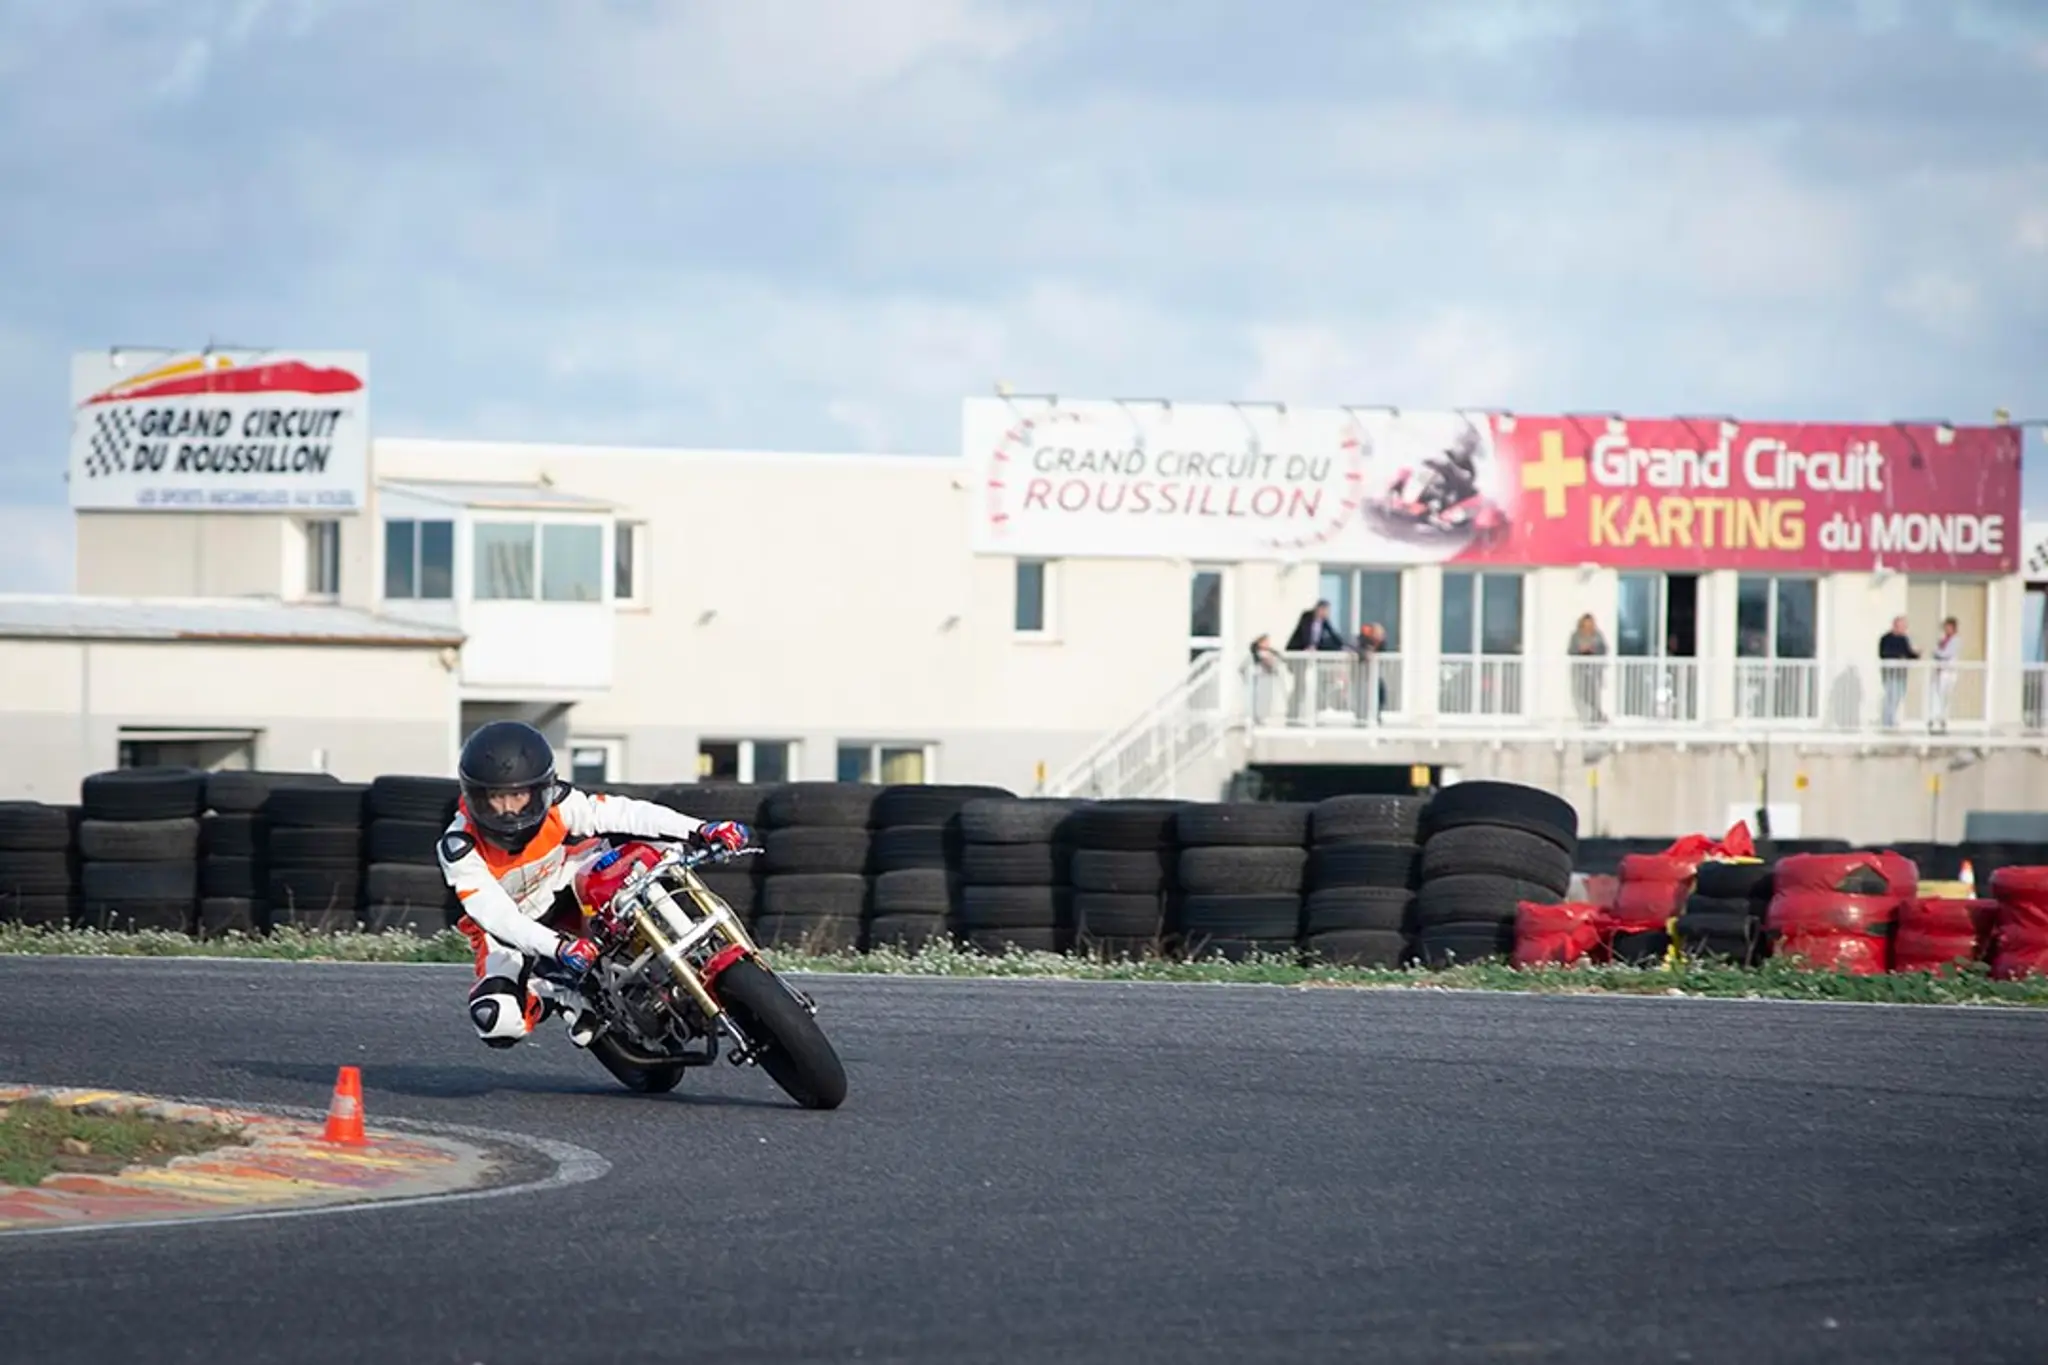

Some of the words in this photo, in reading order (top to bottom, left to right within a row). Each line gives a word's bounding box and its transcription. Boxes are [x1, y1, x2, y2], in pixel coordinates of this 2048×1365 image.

[139, 408, 232, 437] GRAND
[243, 409, 341, 438] CIRCUIT
[132, 445, 168, 472] DU
[175, 445, 332, 473] ROUSSILLON
[1032, 446, 1146, 476] GRAND
[1155, 449, 1278, 480] CIRCUIT
[1284, 455, 1332, 483] DU
[1591, 432, 1729, 489] Grand
[1742, 437, 1885, 492] Circuit
[1023, 479, 1323, 518] ROUSSILLON
[1589, 495, 1806, 550] KARTING
[1819, 514, 1862, 552] du
[1869, 512, 2004, 555] MONDE
